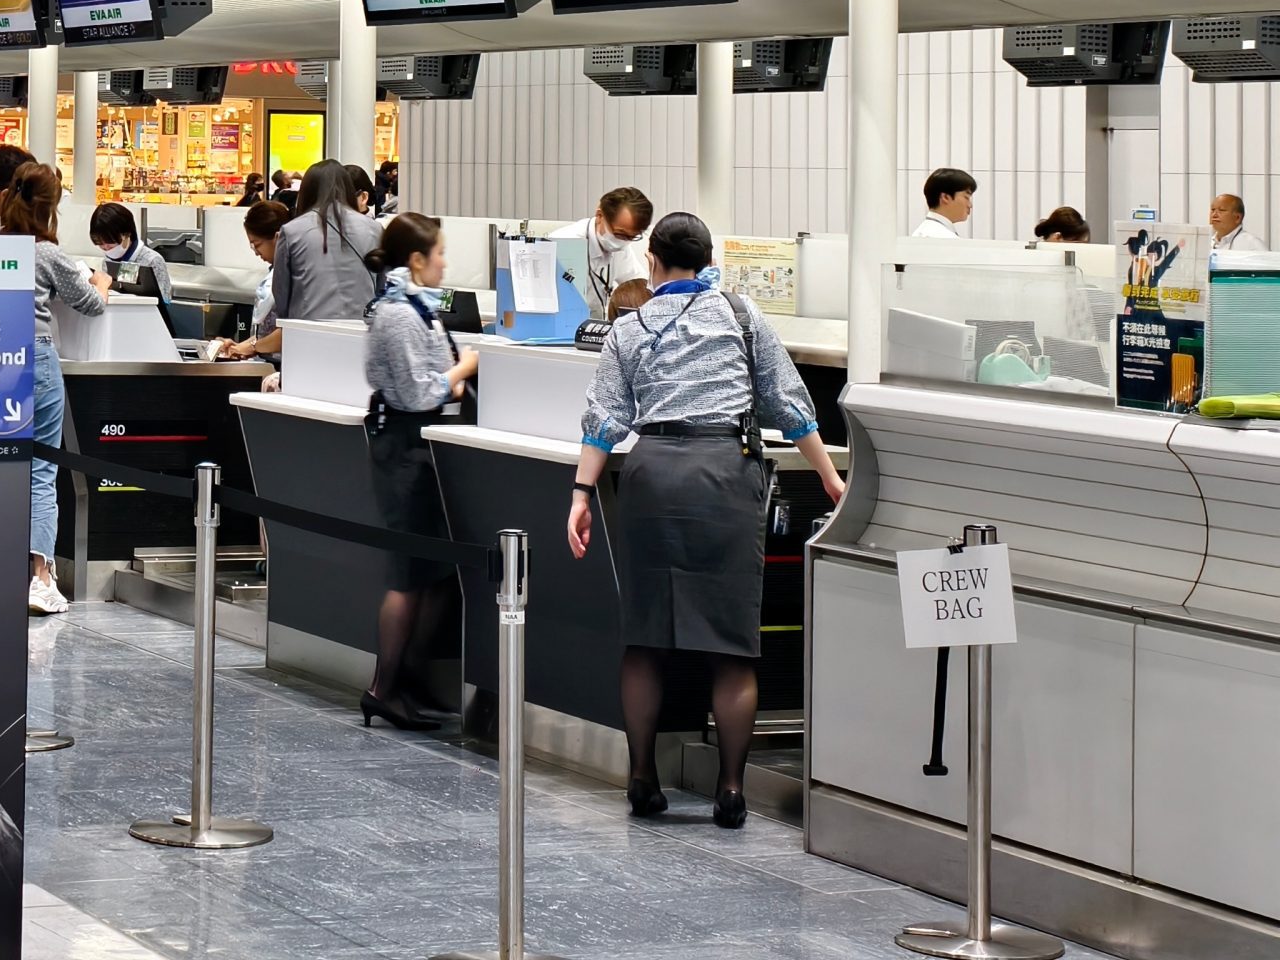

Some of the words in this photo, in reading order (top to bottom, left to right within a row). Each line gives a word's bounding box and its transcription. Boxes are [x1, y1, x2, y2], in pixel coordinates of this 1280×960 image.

[101, 424, 126, 436] 490
[922, 568, 989, 593] CREW
[933, 596, 983, 620] BAG
